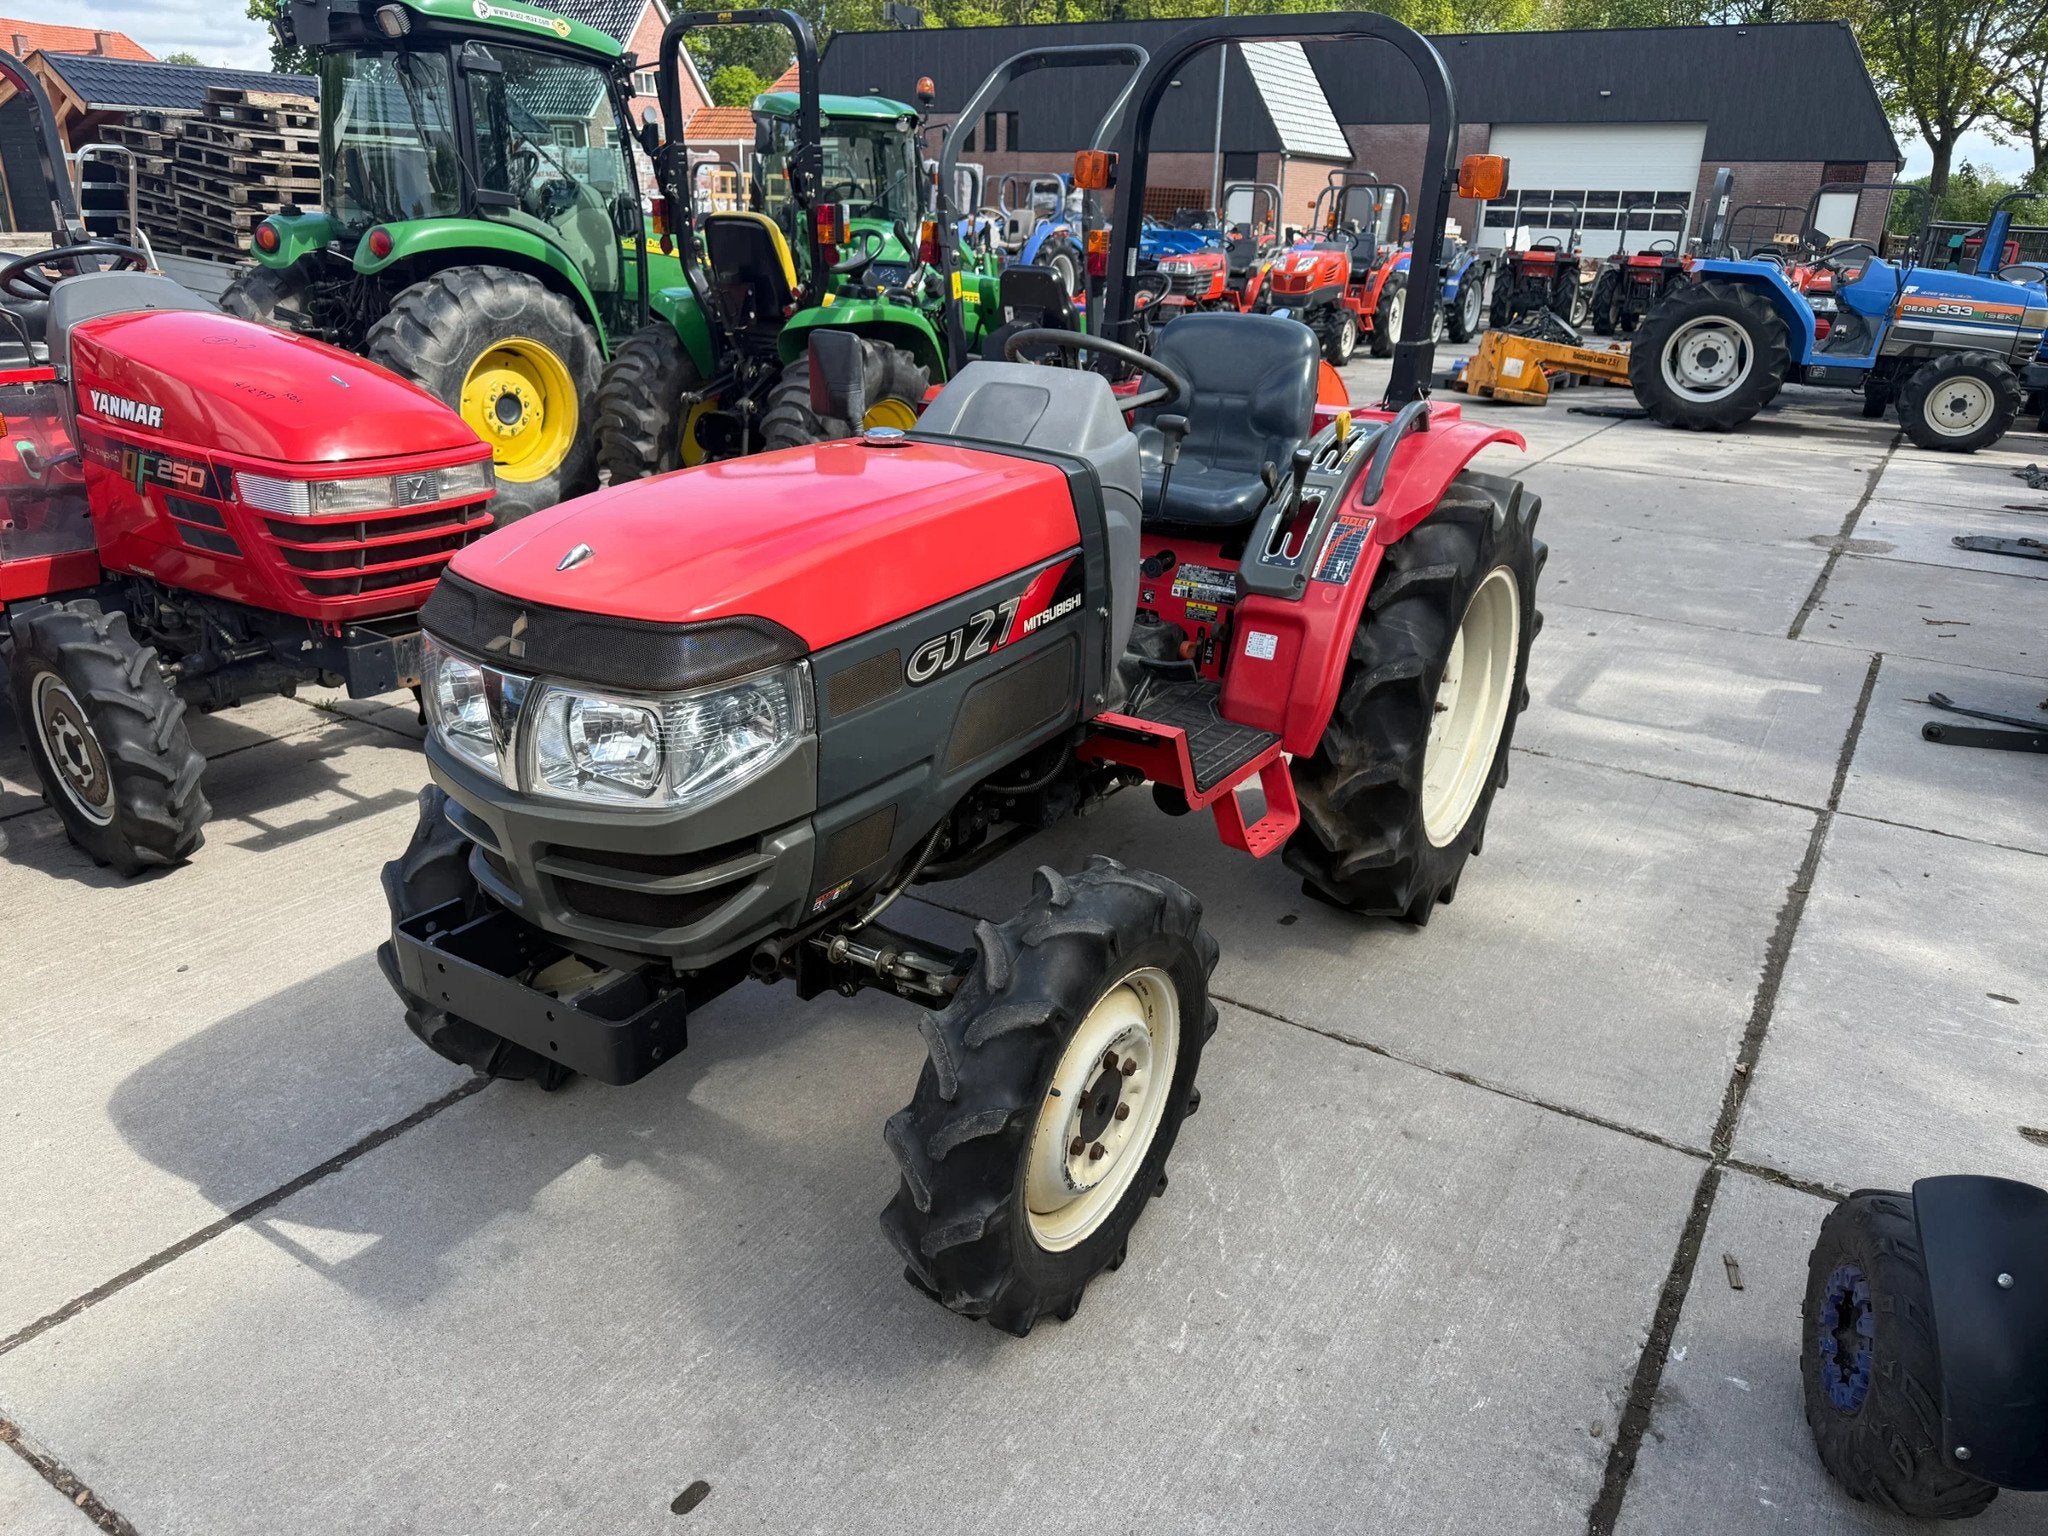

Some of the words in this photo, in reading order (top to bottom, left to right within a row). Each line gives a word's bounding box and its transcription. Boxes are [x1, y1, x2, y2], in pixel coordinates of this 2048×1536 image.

[1936, 303, 1974, 317] 333
[90, 388, 163, 428] YANMAR
[157, 458, 206, 489] 250
[1023, 593, 1081, 634] MITSUBISHI
[906, 595, 1021, 683] GJ27
